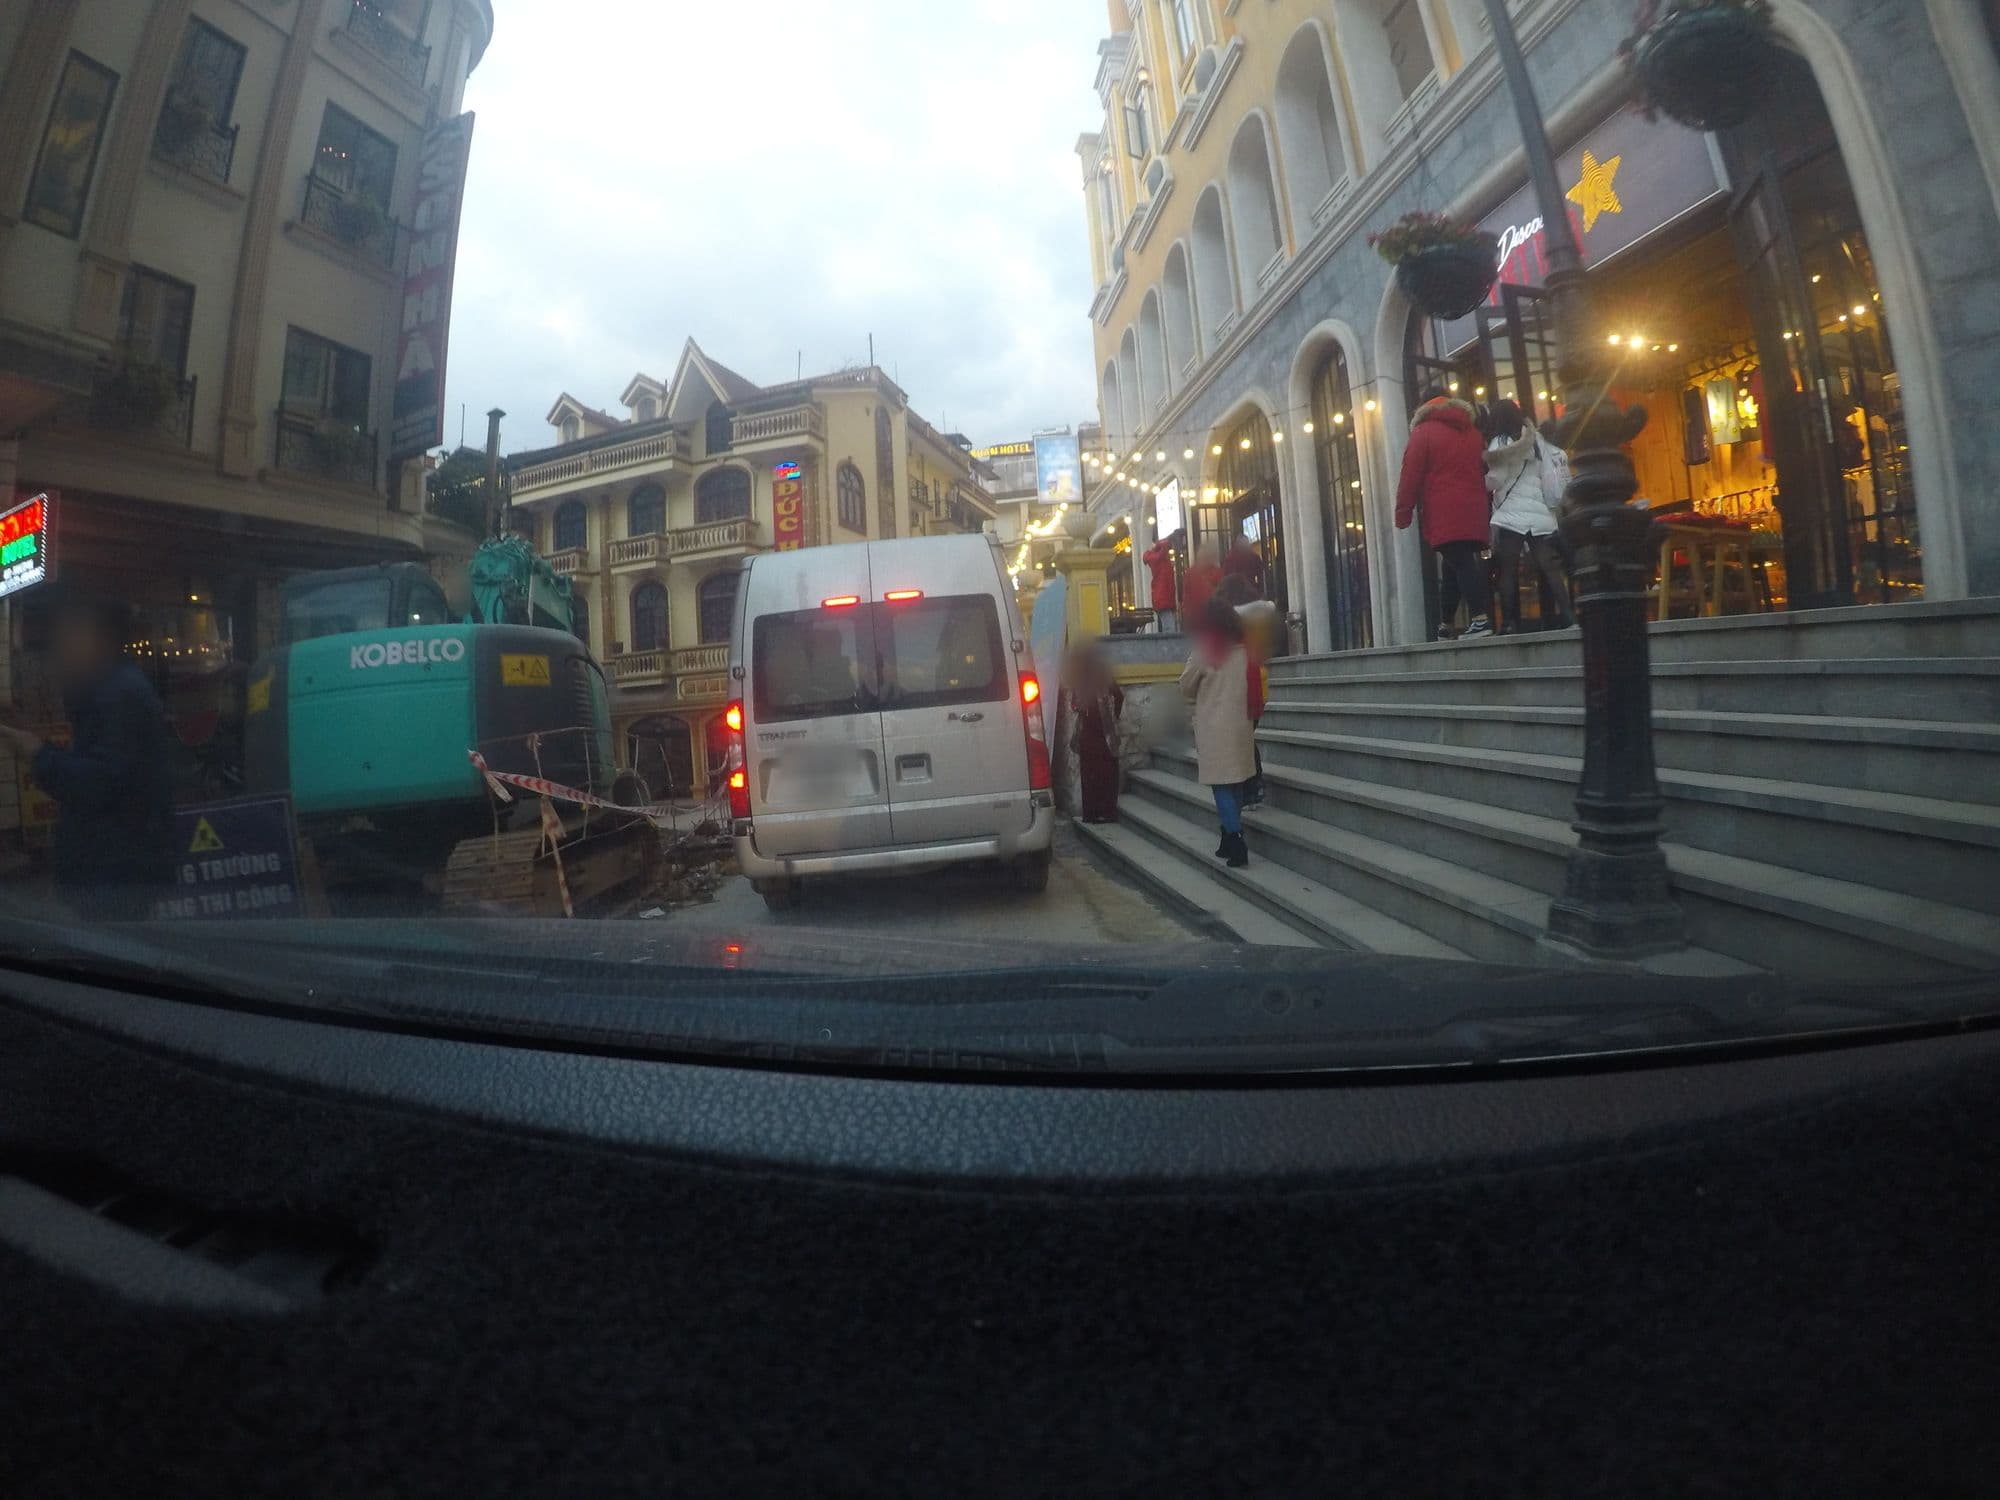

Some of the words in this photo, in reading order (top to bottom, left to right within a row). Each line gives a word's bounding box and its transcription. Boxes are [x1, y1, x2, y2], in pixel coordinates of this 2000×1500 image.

[999, 443, 1031, 455] HOTEL
[350, 637, 465, 669] KOBELCO
[198, 893, 232, 913] THI
